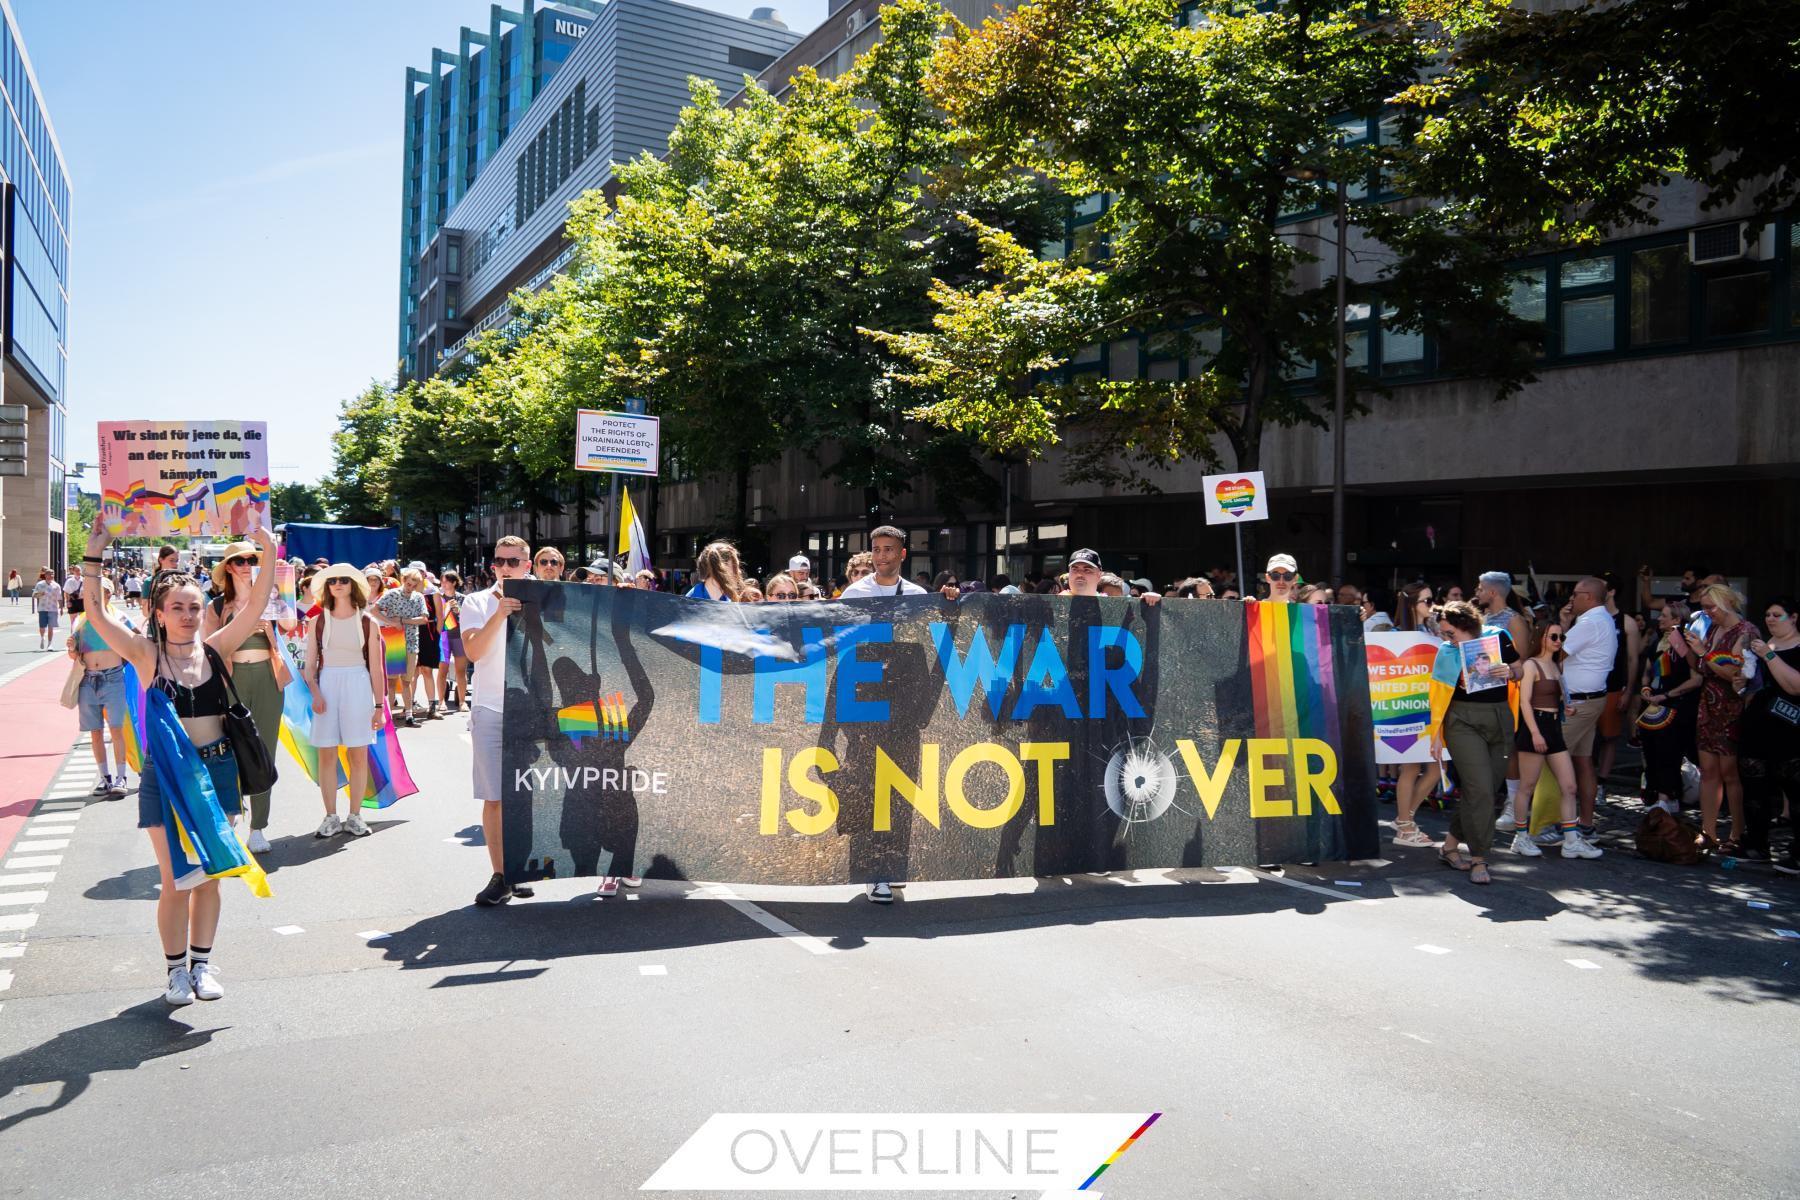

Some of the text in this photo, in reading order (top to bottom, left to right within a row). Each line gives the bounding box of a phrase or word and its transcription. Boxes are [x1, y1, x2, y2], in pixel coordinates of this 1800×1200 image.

[555, 19, 588, 38] NÜR
[602, 420, 636, 429] PROTECT
[113, 430, 262, 442] Wir sind für jene da, die
[591, 427, 606, 435] THE
[608, 428, 635, 437] RIGHTS
[582, 436, 654, 449] UKRAINIAN LGBTQ+
[128, 449, 251, 461] an der Front für uns
[596, 446, 641, 455] DEFENDERS
[160, 469, 217, 481] kämpfen
[676, 623, 1147, 724] THE WAR
[1368, 664, 1429, 675] WE STAND
[1370, 699, 1430, 711] VIL UNION
[514, 766, 669, 794] KYIVPRIDE
[759, 745, 841, 835] IS
[873, 742, 1070, 832] NOT
